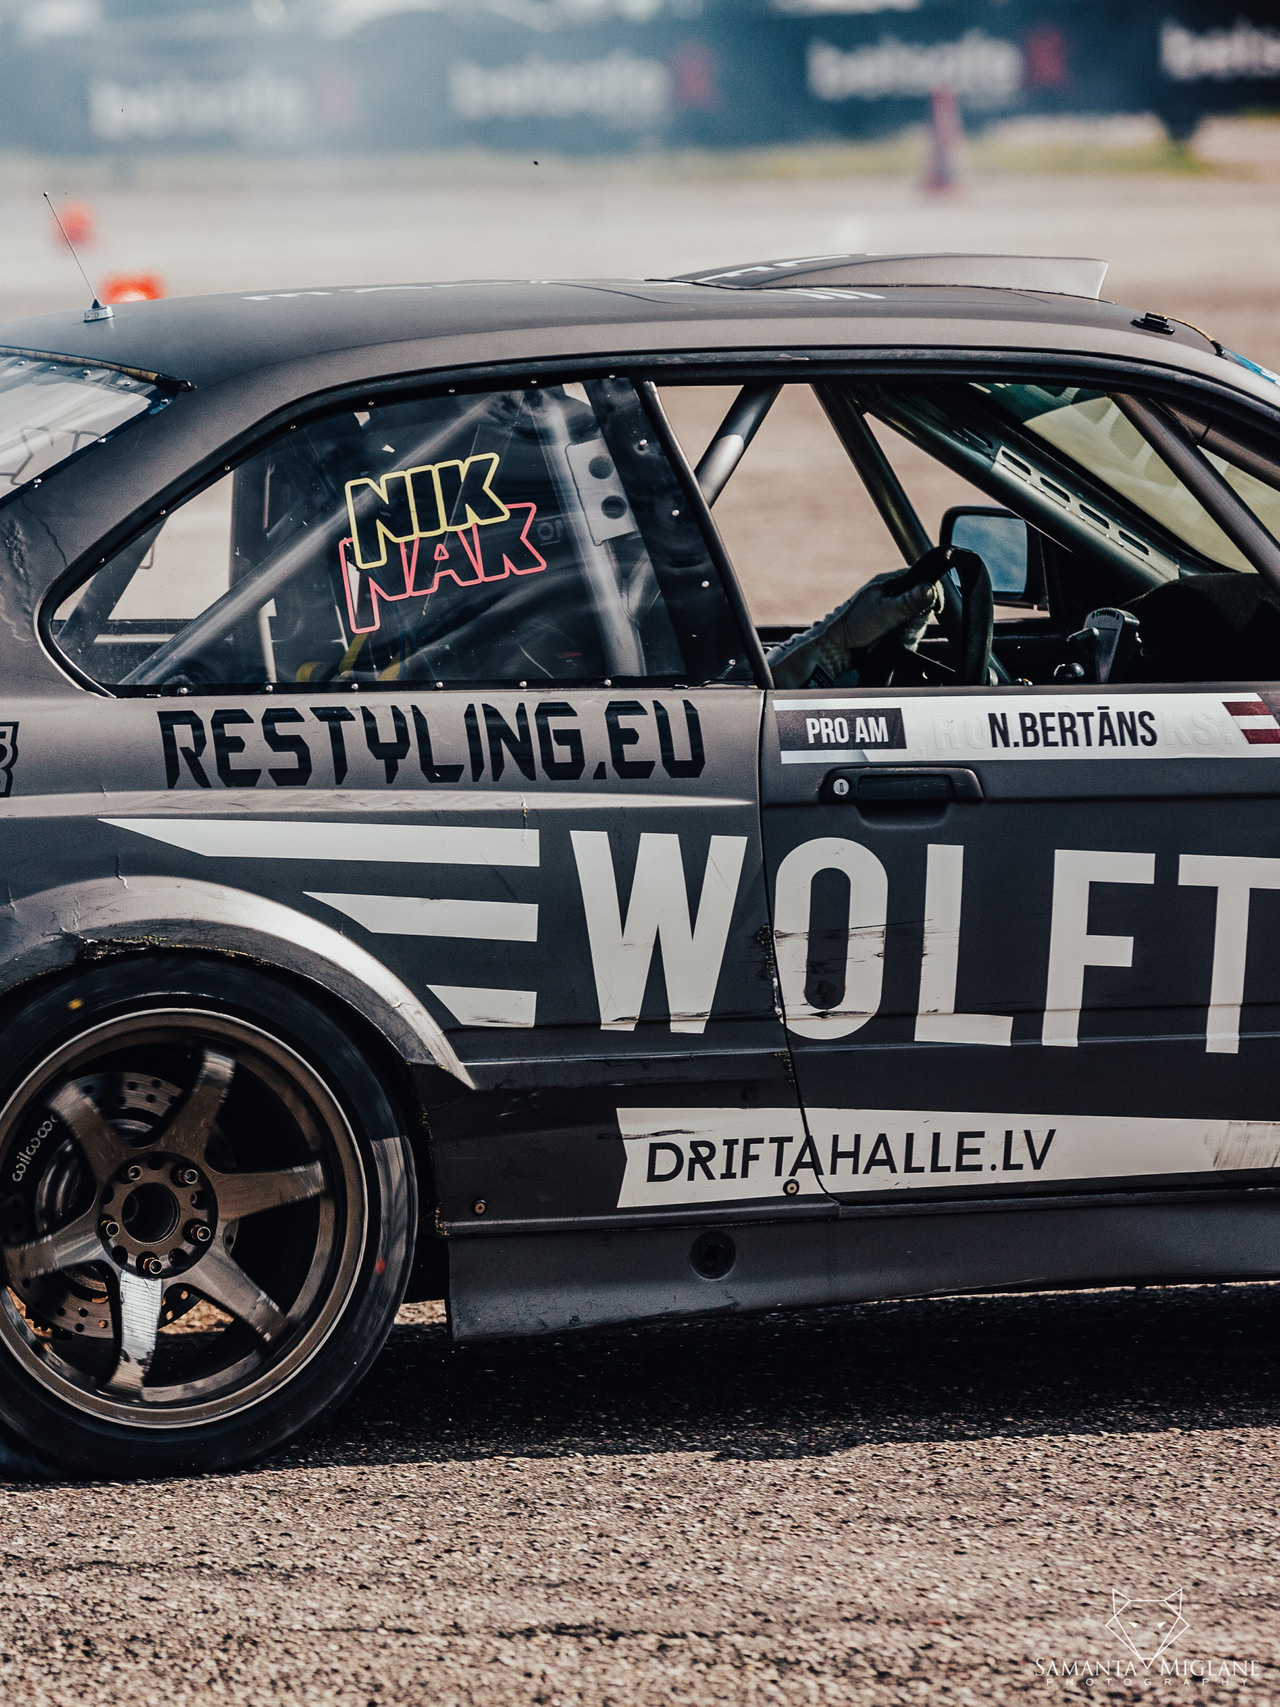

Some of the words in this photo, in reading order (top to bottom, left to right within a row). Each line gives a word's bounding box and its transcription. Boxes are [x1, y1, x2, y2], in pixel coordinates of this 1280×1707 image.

[345, 453, 511, 570] NIK
[339, 502, 547, 634] NAK
[157, 699, 706, 789] RESTYLING.EU
[806, 717, 849, 744] PRO
[854, 716, 889, 743] AM
[988, 706, 1158, 748] N.BERTĀNS
[569, 830, 1280, 1054] WOLFT
[646, 1128, 1057, 1183] DRIFTAHALLE.LV
